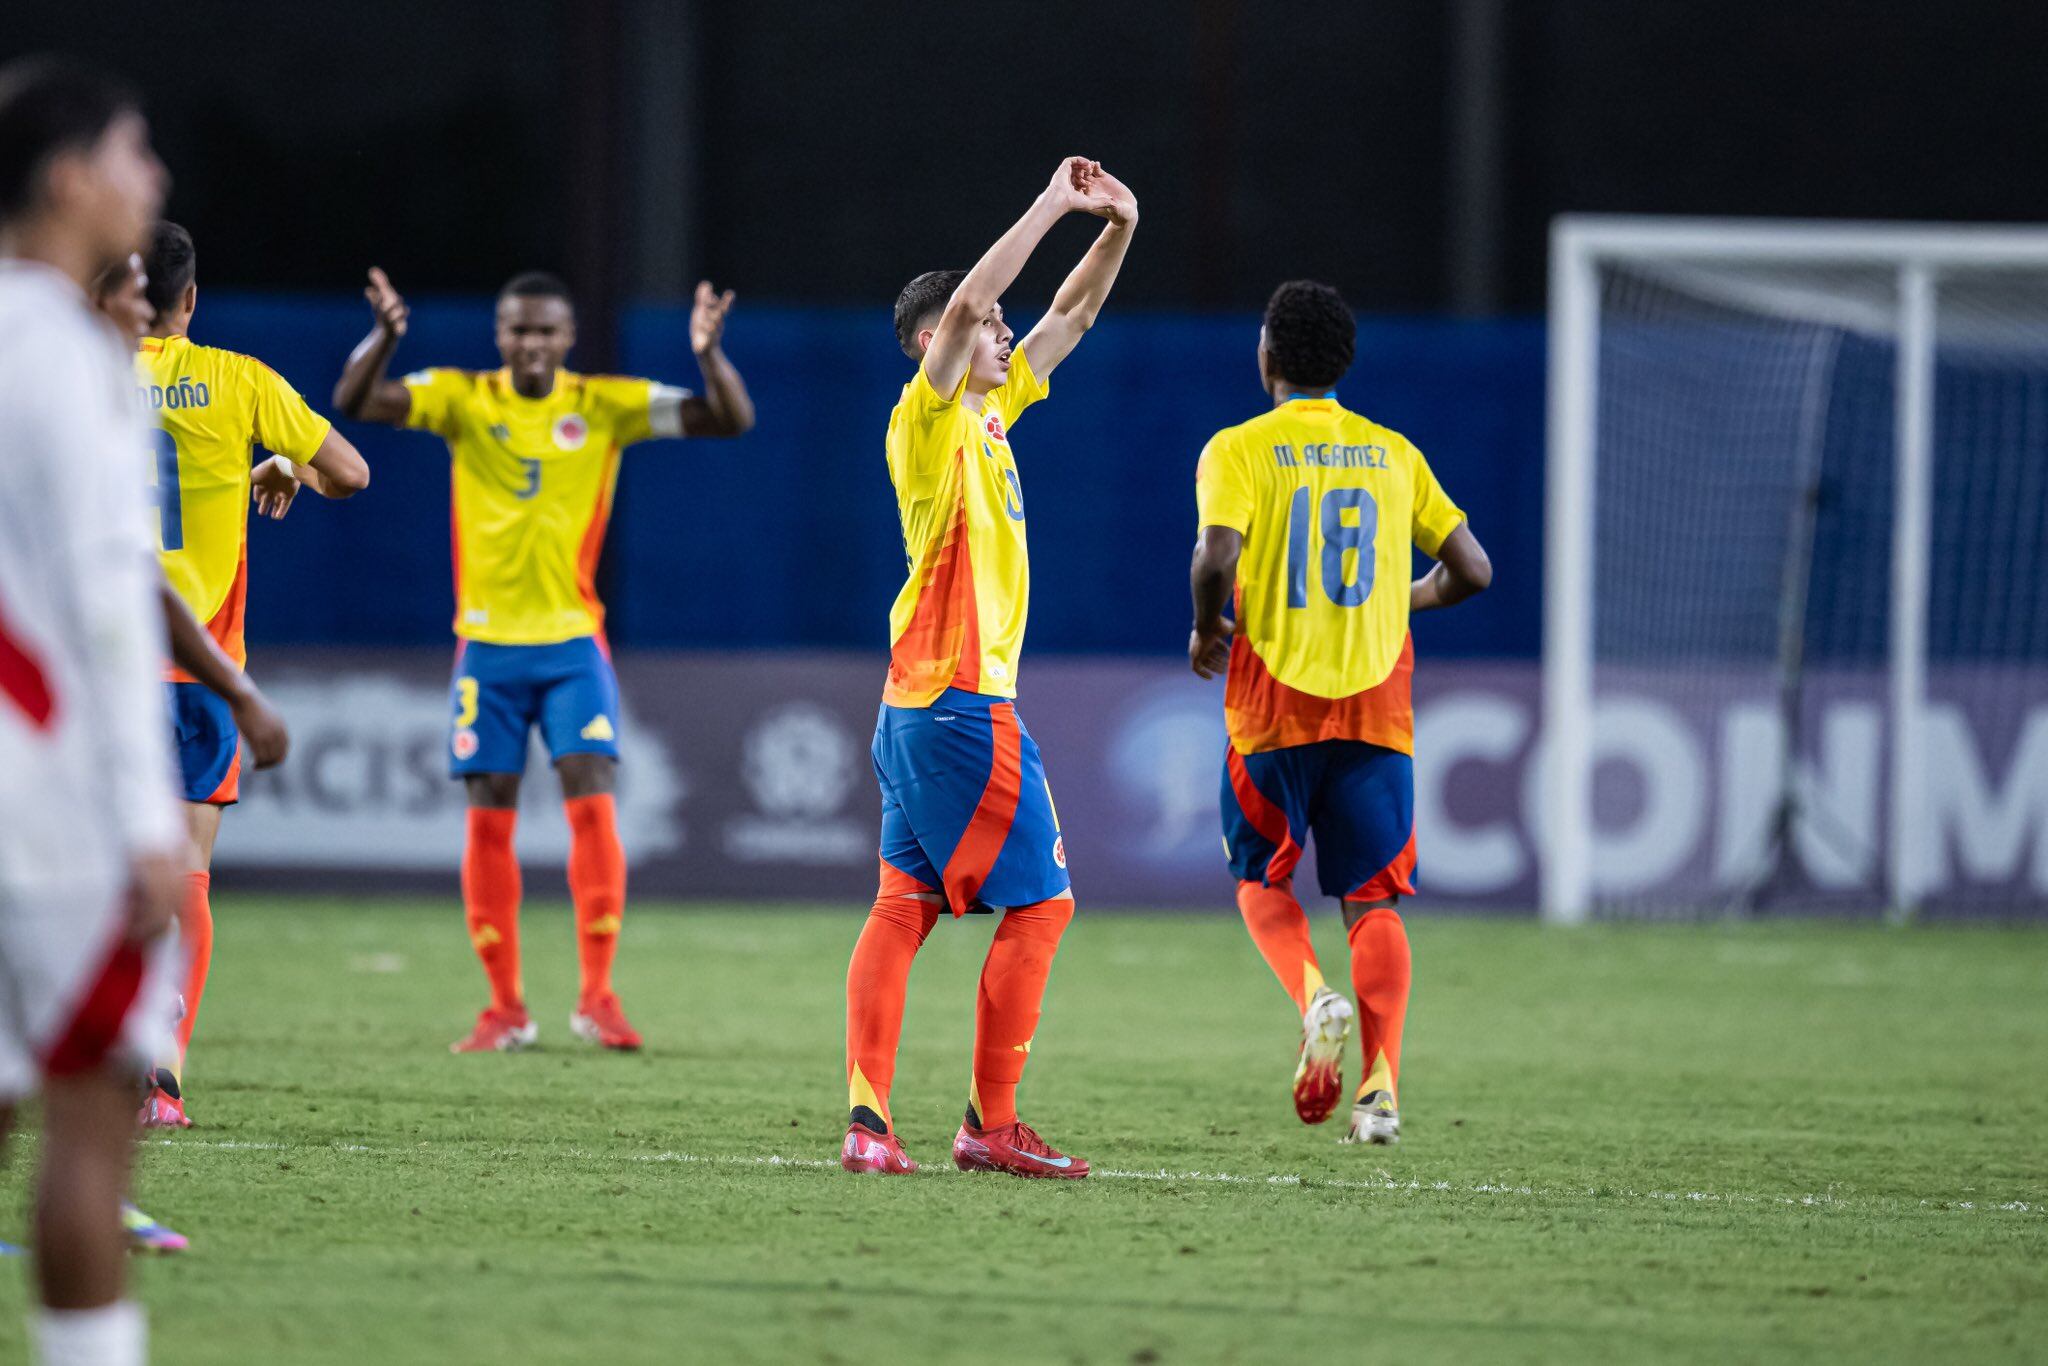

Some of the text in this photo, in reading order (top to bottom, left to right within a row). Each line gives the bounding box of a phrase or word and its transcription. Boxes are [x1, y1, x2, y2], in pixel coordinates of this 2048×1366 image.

[516, 458, 542, 500] 3
[1304, 443, 1389, 469] AGAMEZ
[1287, 486, 1378, 608] 18
[456, 675, 480, 728] 3
